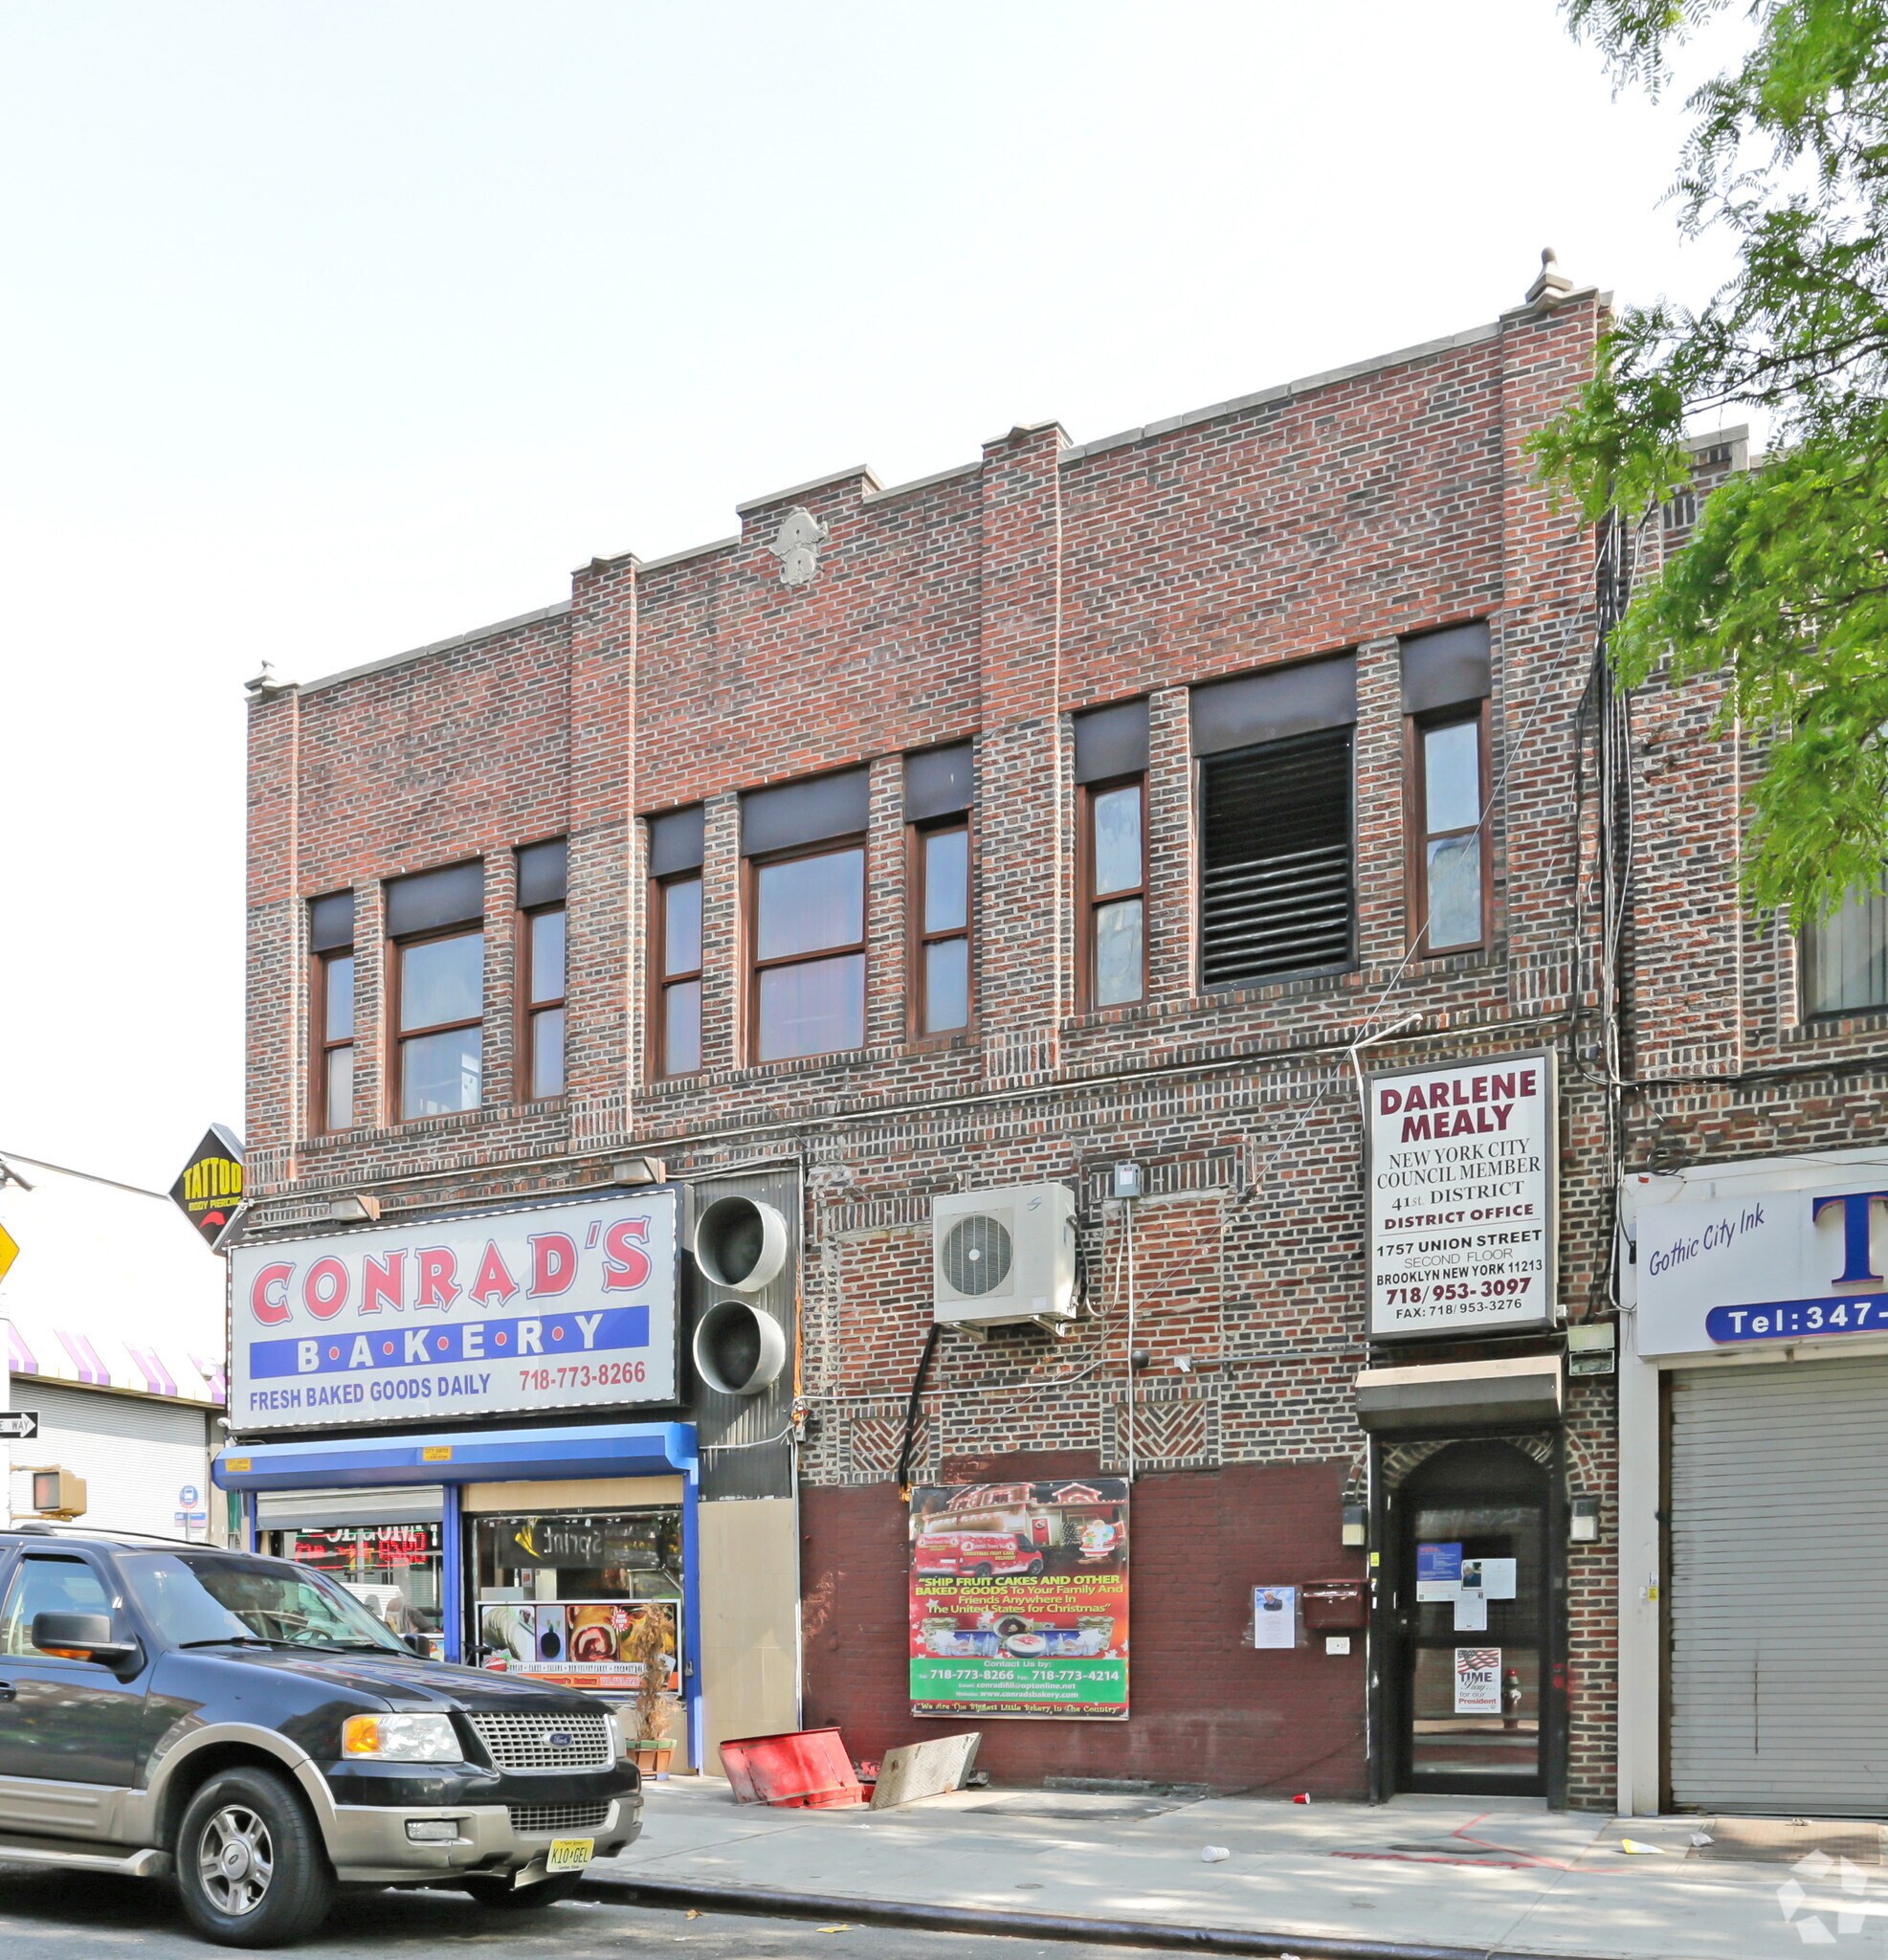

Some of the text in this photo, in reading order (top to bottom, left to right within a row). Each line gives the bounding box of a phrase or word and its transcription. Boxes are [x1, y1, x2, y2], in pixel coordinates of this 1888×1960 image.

[1380, 1069, 1537, 1116] DARLENE
[1401, 1103, 1514, 1144] MEALY
[1388, 1137, 1531, 1169] NEW YORK CITY
[183, 1157, 242, 1200] TATTOO
[1377, 1156, 1542, 1190] COUNCIL MEMBER
[1430, 1180, 1524, 1205] DISTRICT
[189, 1201, 209, 1212] BODY
[1385, 1204, 1534, 1230] DISTRICT OFFICE
[1377, 1229, 1543, 1258] 1757 UNION STREET
[1649, 1202, 1765, 1276] Gothic City Ink
[1404, 1248, 1514, 1269] SECOND FLOOR
[250, 1215, 653, 1326] CONRAD'S
[1376, 1258, 1543, 1286] BROOKLYN NEW YORK 11213
[1396, 1306, 1427, 1319] FAX:
[250, 1361, 646, 1412] FRESH BAKED GOODS DAILY 718-773-8266
[11, 1420, 29, 1431] WAY
[915, 1584, 1123, 1596] BAKED GOODS To Your Family And
[956, 1576, 993, 1587] FRUIT
[994, 1576, 1038, 1586] CAKES
[1040, 1575, 1071, 1585] AND
[1073, 1574, 1121, 1585] OTHER
[928, 1605, 948, 1614] The
[950, 1604, 988, 1614] United
[991, 1604, 1026, 1614] States
[1028, 1604, 1044, 1613] for
[958, 1594, 1077, 1606] Friends Anywhere In
[930, 1669, 1014, 1681] 718-773-8266
[1032, 1670, 1120, 1682] 718-773-4214
[1038, 1660, 1052, 1669] by:
[1459, 1672, 1492, 1682] TIME
[980, 1691, 1078, 1700] www.conradsbakery.com
